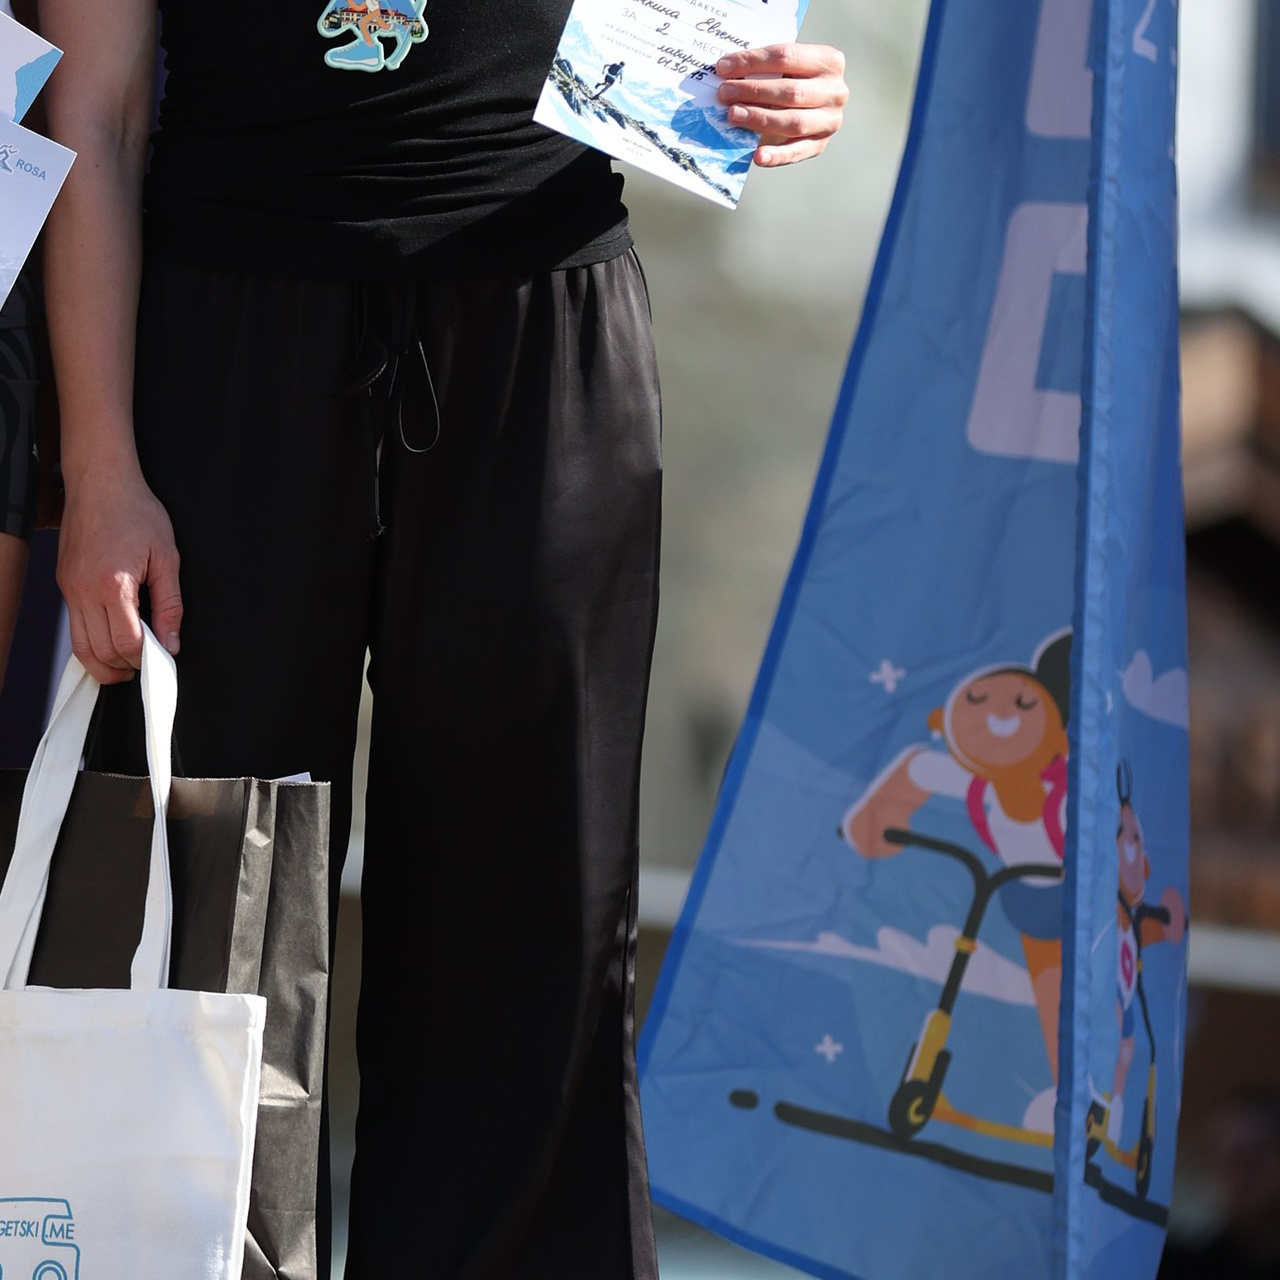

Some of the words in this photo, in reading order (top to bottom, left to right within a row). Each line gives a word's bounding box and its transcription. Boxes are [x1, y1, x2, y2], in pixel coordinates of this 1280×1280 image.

[620, 7, 637, 21] ЗА
[655, 22, 671, 36] 2
[16, 158, 47, 181] ROSA
